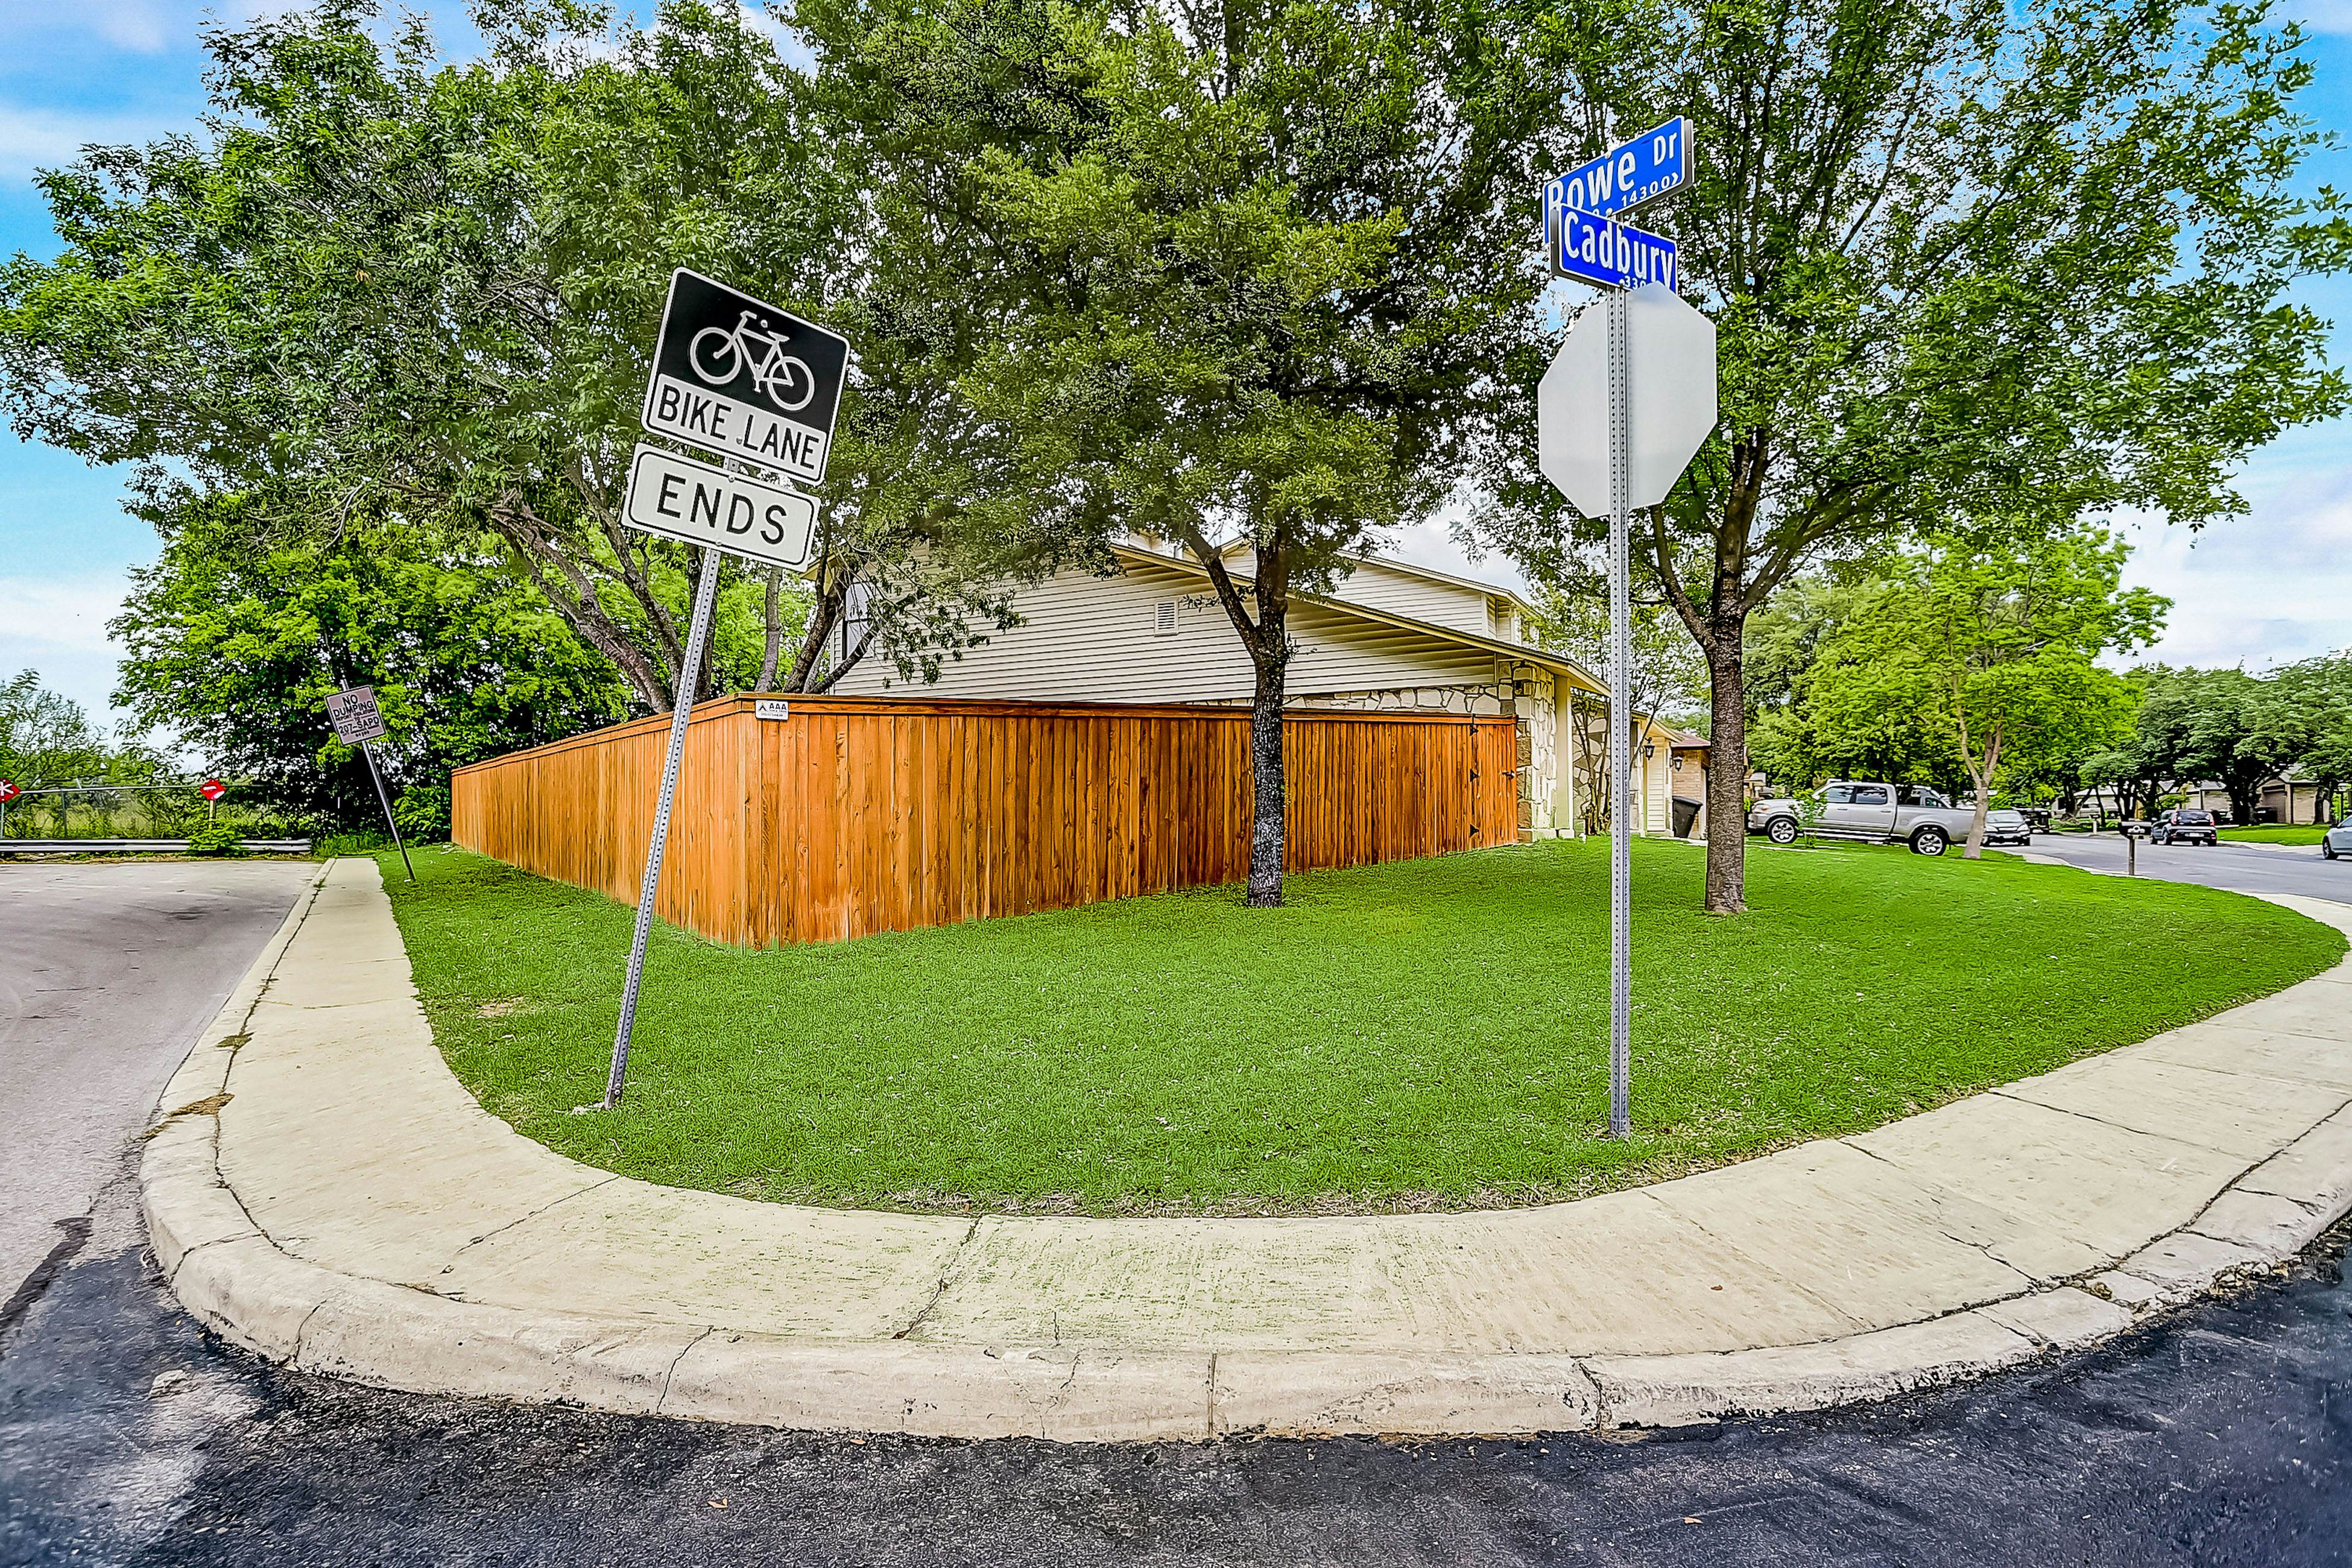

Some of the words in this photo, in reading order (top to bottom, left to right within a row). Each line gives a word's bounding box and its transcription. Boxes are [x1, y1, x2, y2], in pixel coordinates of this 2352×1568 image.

[1654, 132, 1678, 166] Dr
[1621, 177, 1671, 207] 14300
[1564, 211, 1674, 289] Cadbury
[657, 384, 732, 440] BIKE
[744, 414, 820, 470] LANE
[657, 473, 787, 545] ENDS
[333, 701, 374, 716] DUMPING
[343, 695, 358, 707] NO
[339, 716, 380, 733] 207-SAPD
